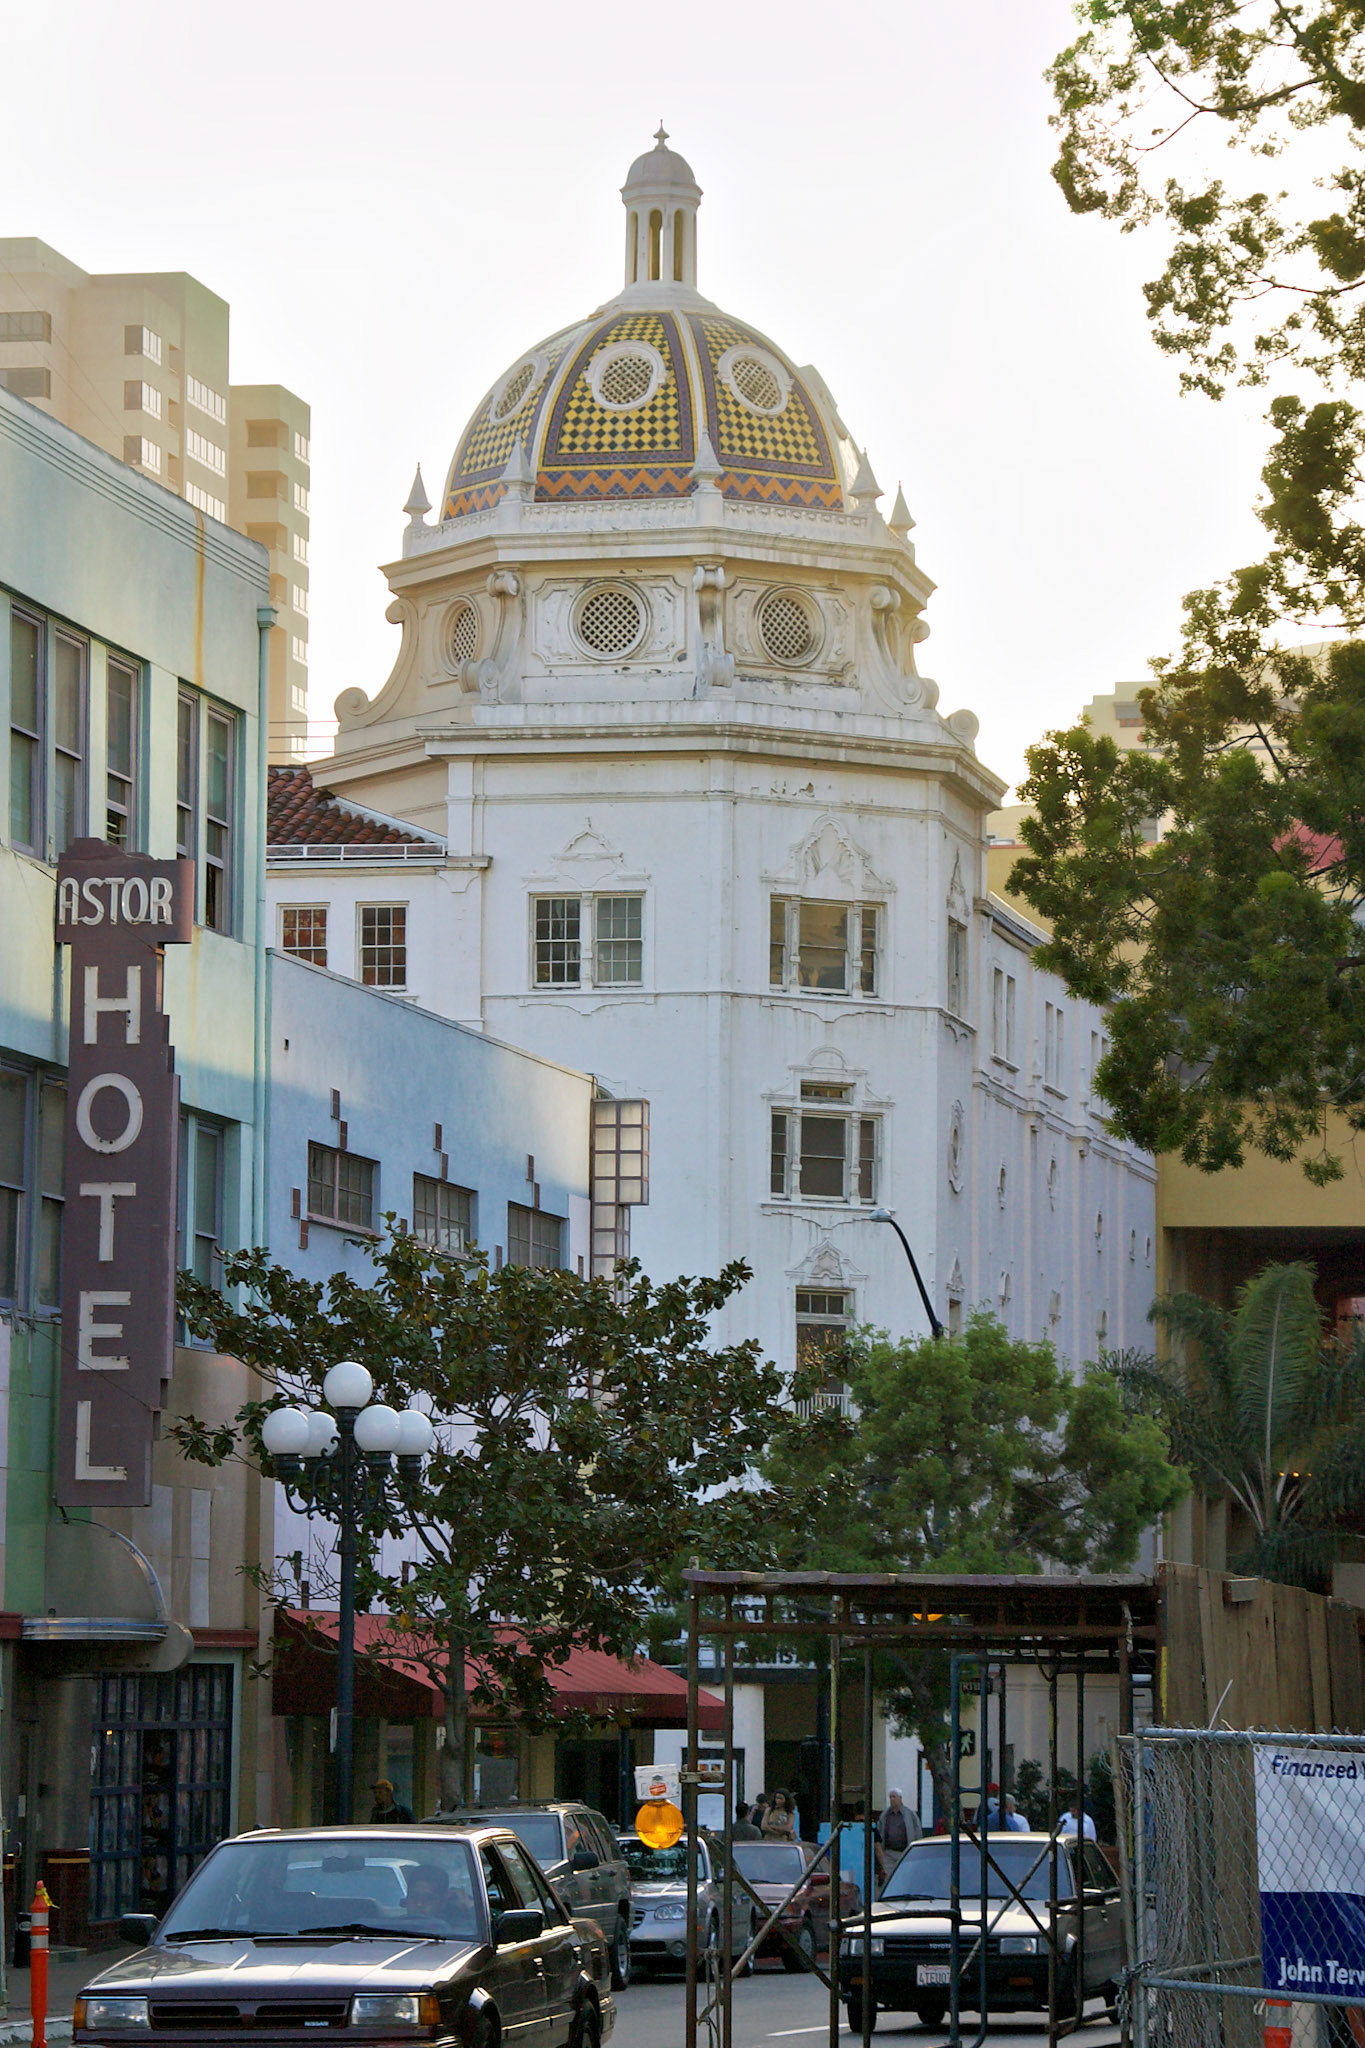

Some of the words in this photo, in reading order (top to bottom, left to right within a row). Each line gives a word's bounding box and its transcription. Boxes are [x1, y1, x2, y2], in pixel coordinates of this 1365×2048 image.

[58, 876, 173, 925] ASTOR
[75, 965, 143, 1481] HOTEL
[1272, 1755, 1358, 1779] Financed
[1277, 1957, 1322, 1986] John
